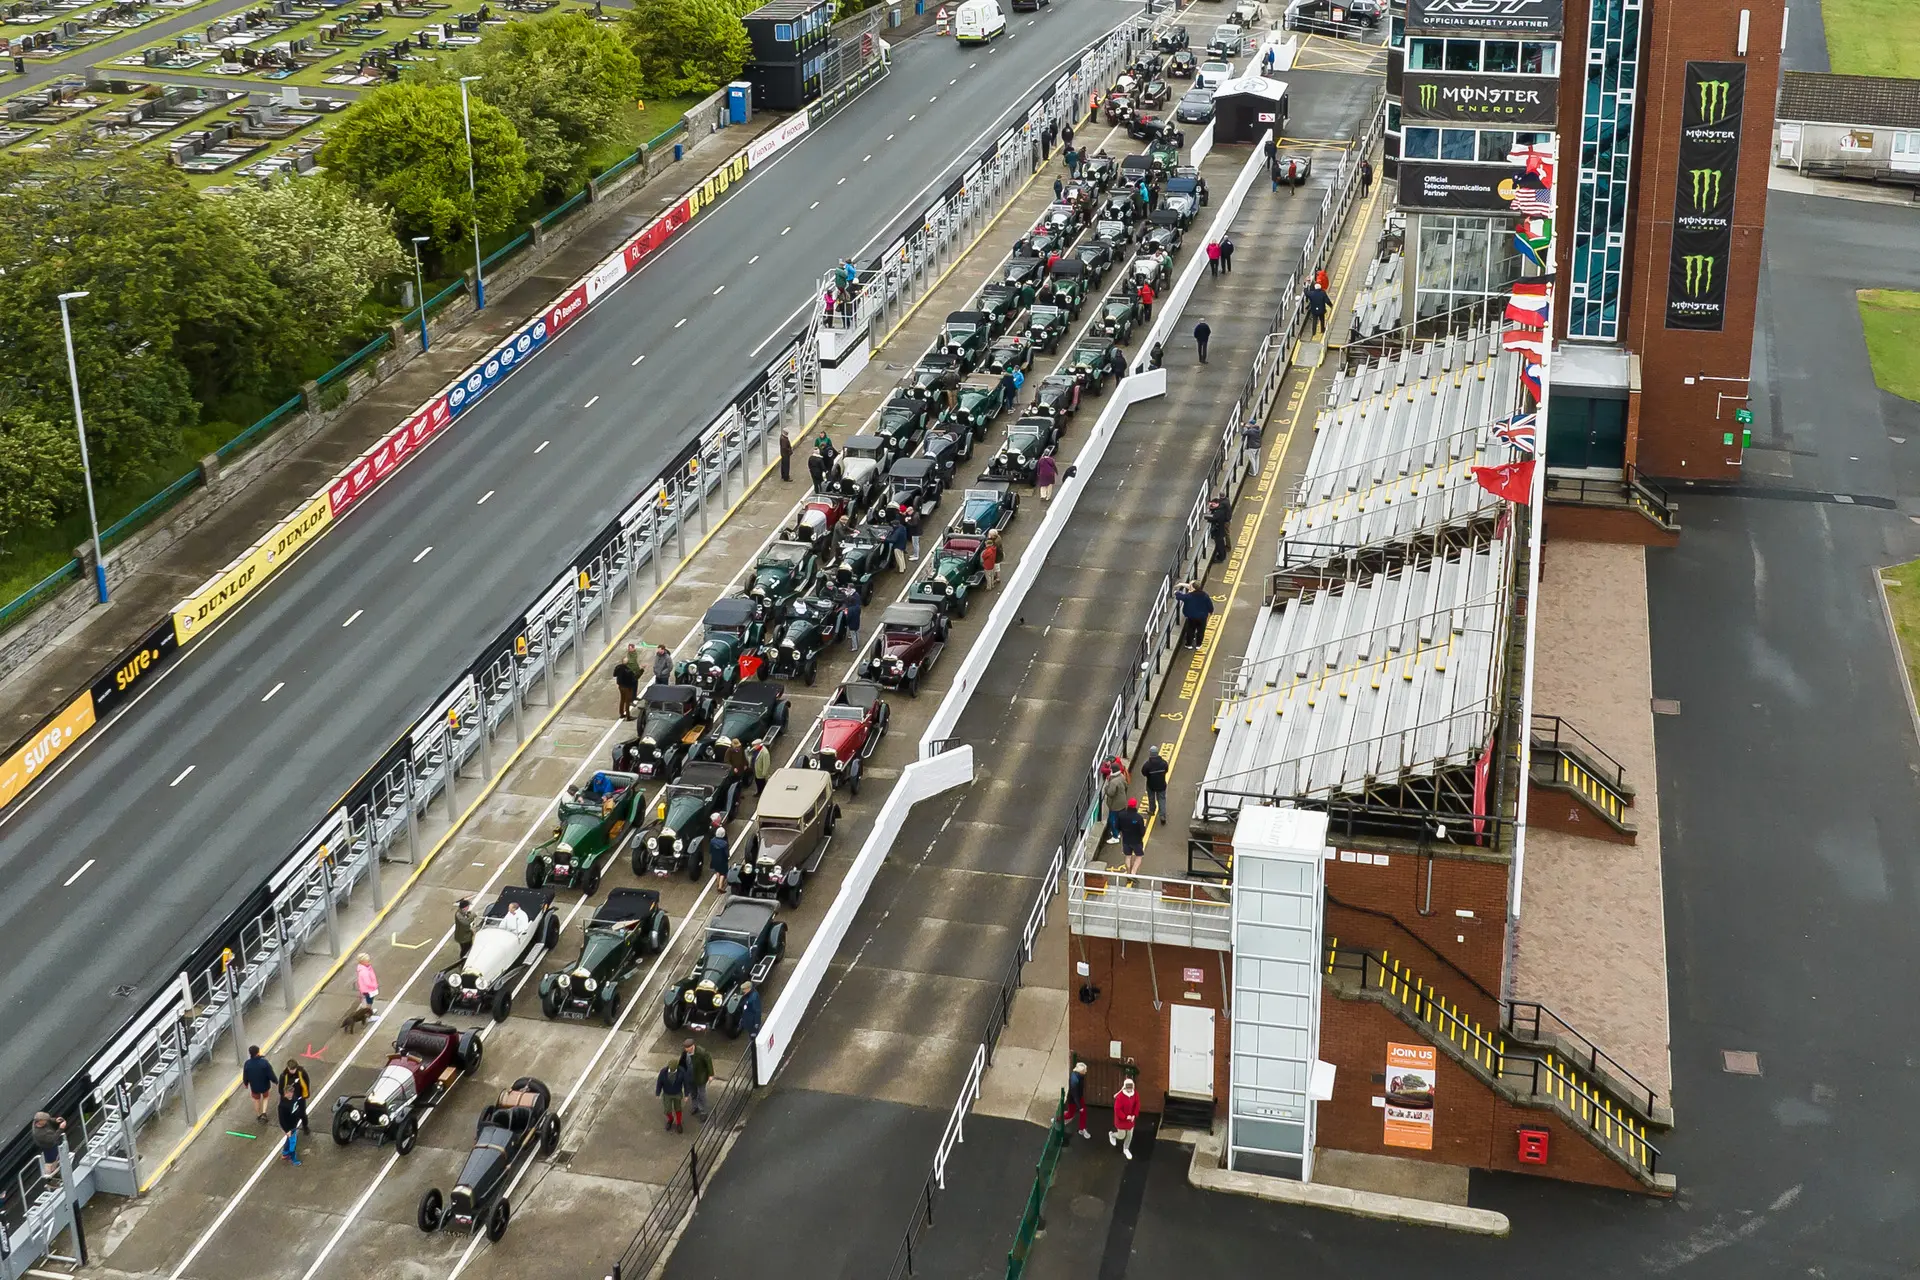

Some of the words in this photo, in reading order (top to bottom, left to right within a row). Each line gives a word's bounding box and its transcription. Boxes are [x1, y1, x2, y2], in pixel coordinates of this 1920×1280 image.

[1423, 17, 1465, 25] OFFICIAL
[1506, 20, 1549, 28] PARTNER
[1456, 105, 1525, 114] ENERGY
[1424, 175, 1448, 183] Official
[1424, 182, 1491, 193] Telecommunications
[277, 504, 326, 556] DUNLOP
[197, 565, 256, 621] DUNLOP
[1391, 1047, 1417, 1058] JOIN
[1418, 1051, 1433, 1059] US
